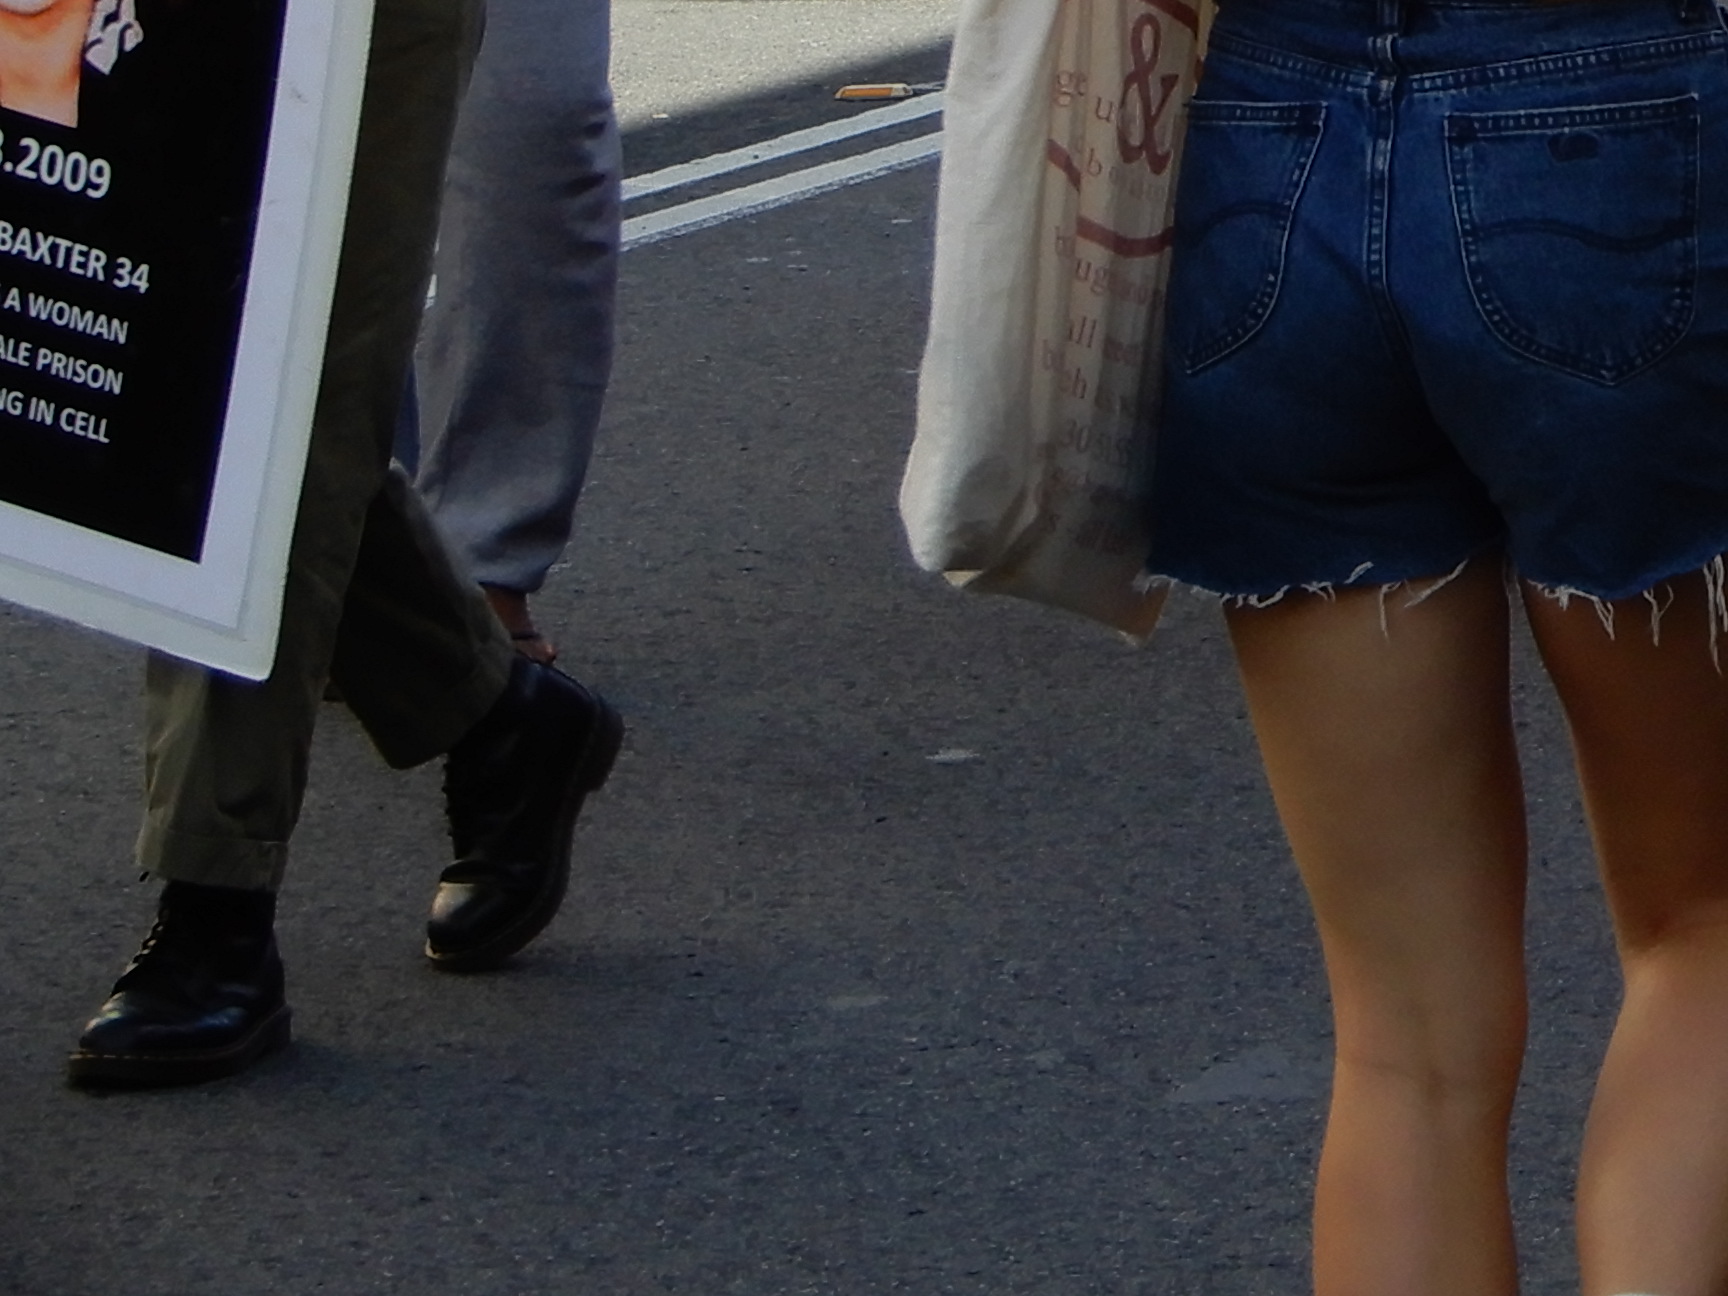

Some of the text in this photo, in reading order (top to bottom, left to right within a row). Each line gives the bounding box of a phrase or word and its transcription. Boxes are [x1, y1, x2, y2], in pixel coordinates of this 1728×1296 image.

[0, 220, 150, 295] BAXTER 34
[4, 287, 129, 345] A WOMAN
[0, 333, 124, 395] LE PRISON
[28, 396, 55, 426] IN
[59, 407, 111, 444] CELL
